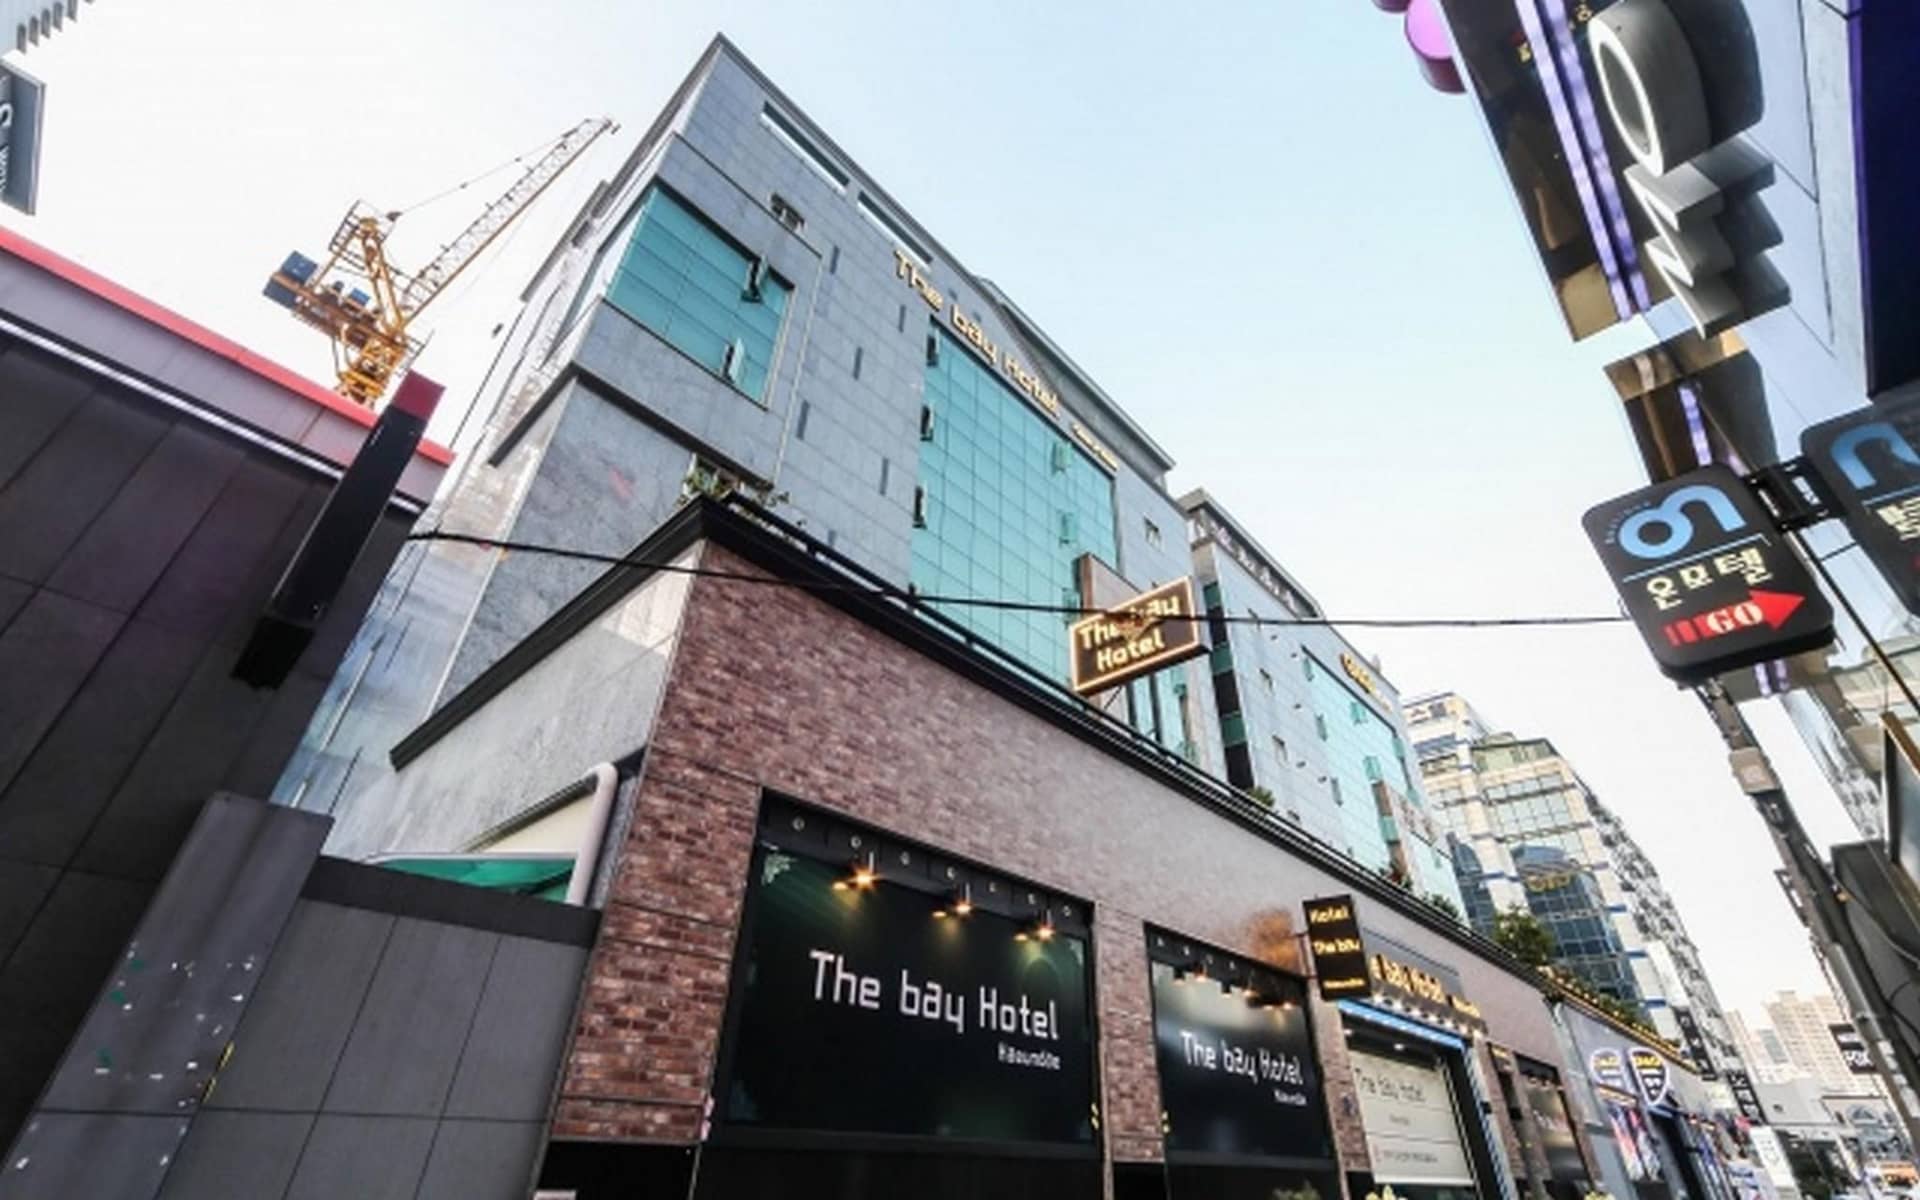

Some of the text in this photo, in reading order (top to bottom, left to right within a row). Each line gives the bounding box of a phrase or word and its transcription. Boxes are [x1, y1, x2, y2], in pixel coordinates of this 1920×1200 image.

[1706, 601, 1763, 634] GO
[1097, 628, 1165, 671] Hotel
[810, 949, 1060, 1041] The bay Hotel
[1180, 1031, 1304, 1085] The bay Hotel
